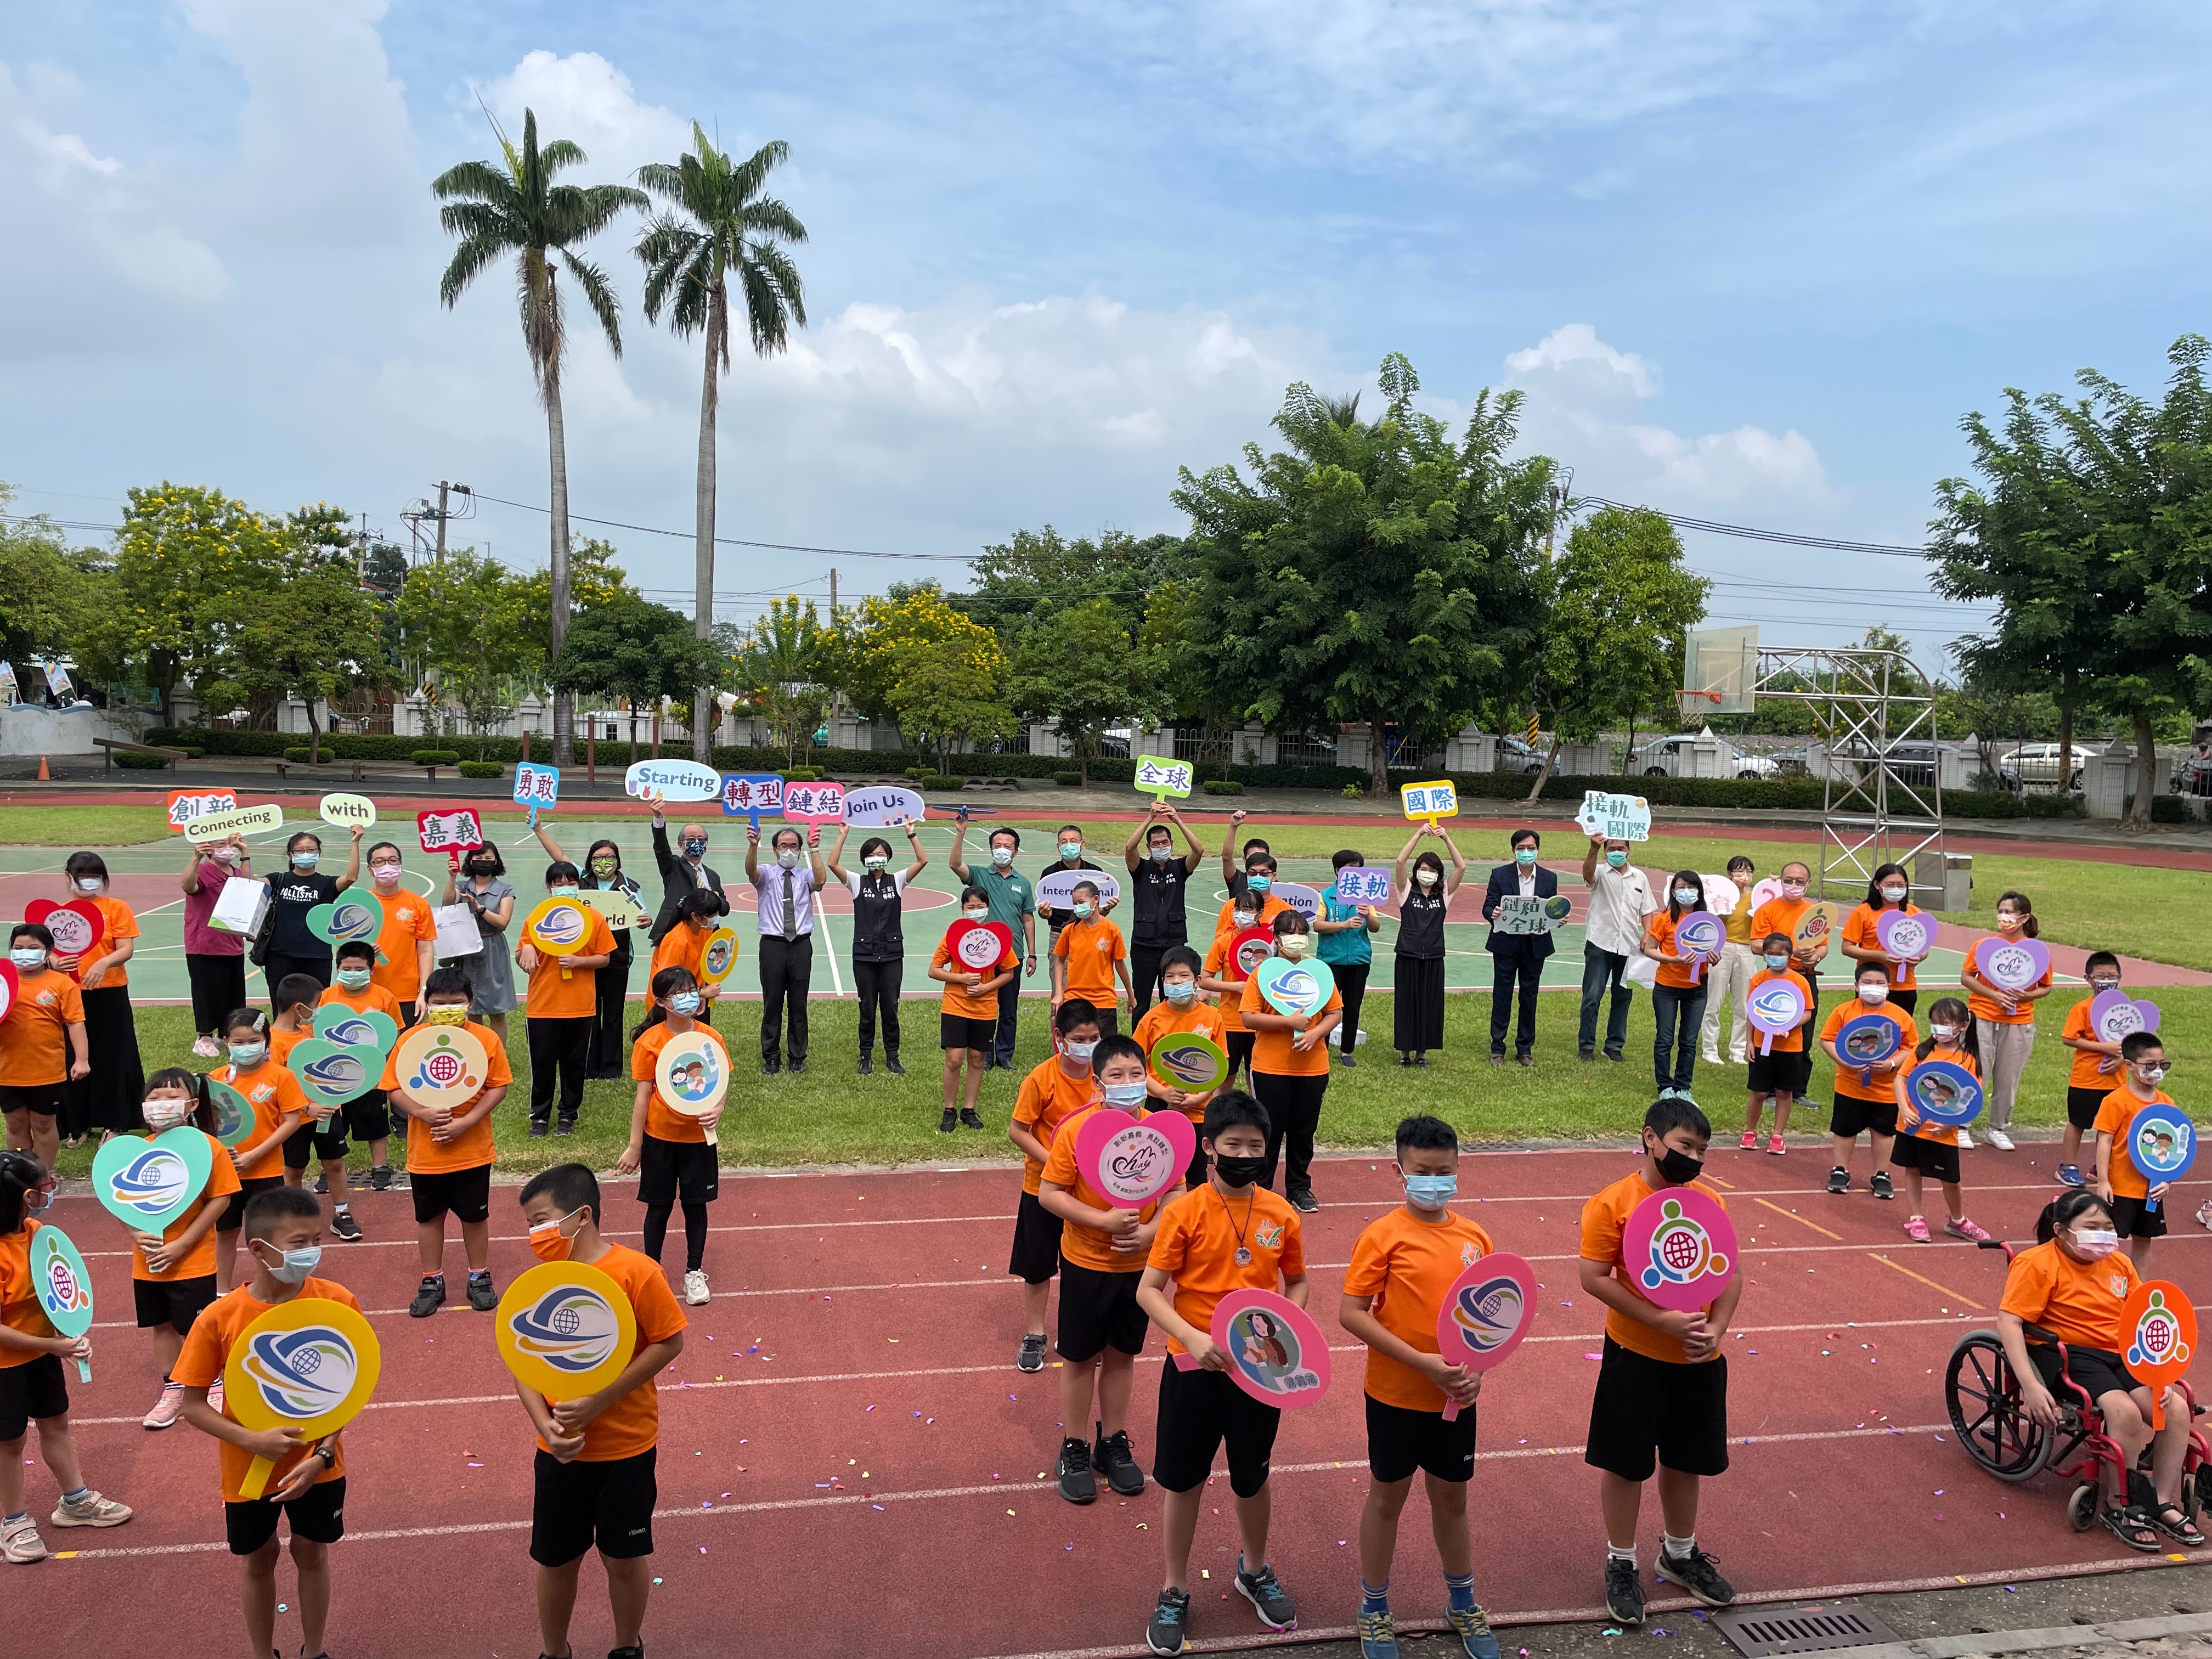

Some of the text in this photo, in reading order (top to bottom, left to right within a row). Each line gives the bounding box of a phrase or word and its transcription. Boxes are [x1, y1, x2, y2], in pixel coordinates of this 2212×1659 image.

[516, 770, 554, 799] 勇敢
[639, 768, 715, 792] Starting
[1138, 762, 1189, 789] 全球
[726, 781, 781, 808] 轉型
[787, 790, 842, 814] 鏈結
[847, 794, 905, 817] Join Us
[1406, 788, 1454, 812] 國際
[1587, 793, 1629, 819] 接軌
[172, 797, 235, 822] 創新
[326, 802, 368, 818] with
[188, 811, 271, 836] Connecting
[424, 814, 479, 845] 嘉義
[1607, 821, 1646, 840] 國際
[1043, 886, 1113, 896] Internal
[1339, 872, 1387, 897] 接軌
[1502, 897, 1540, 916] 鏈結
[605, 914, 625, 925] rld
[1509, 917, 1547, 933] 全球
